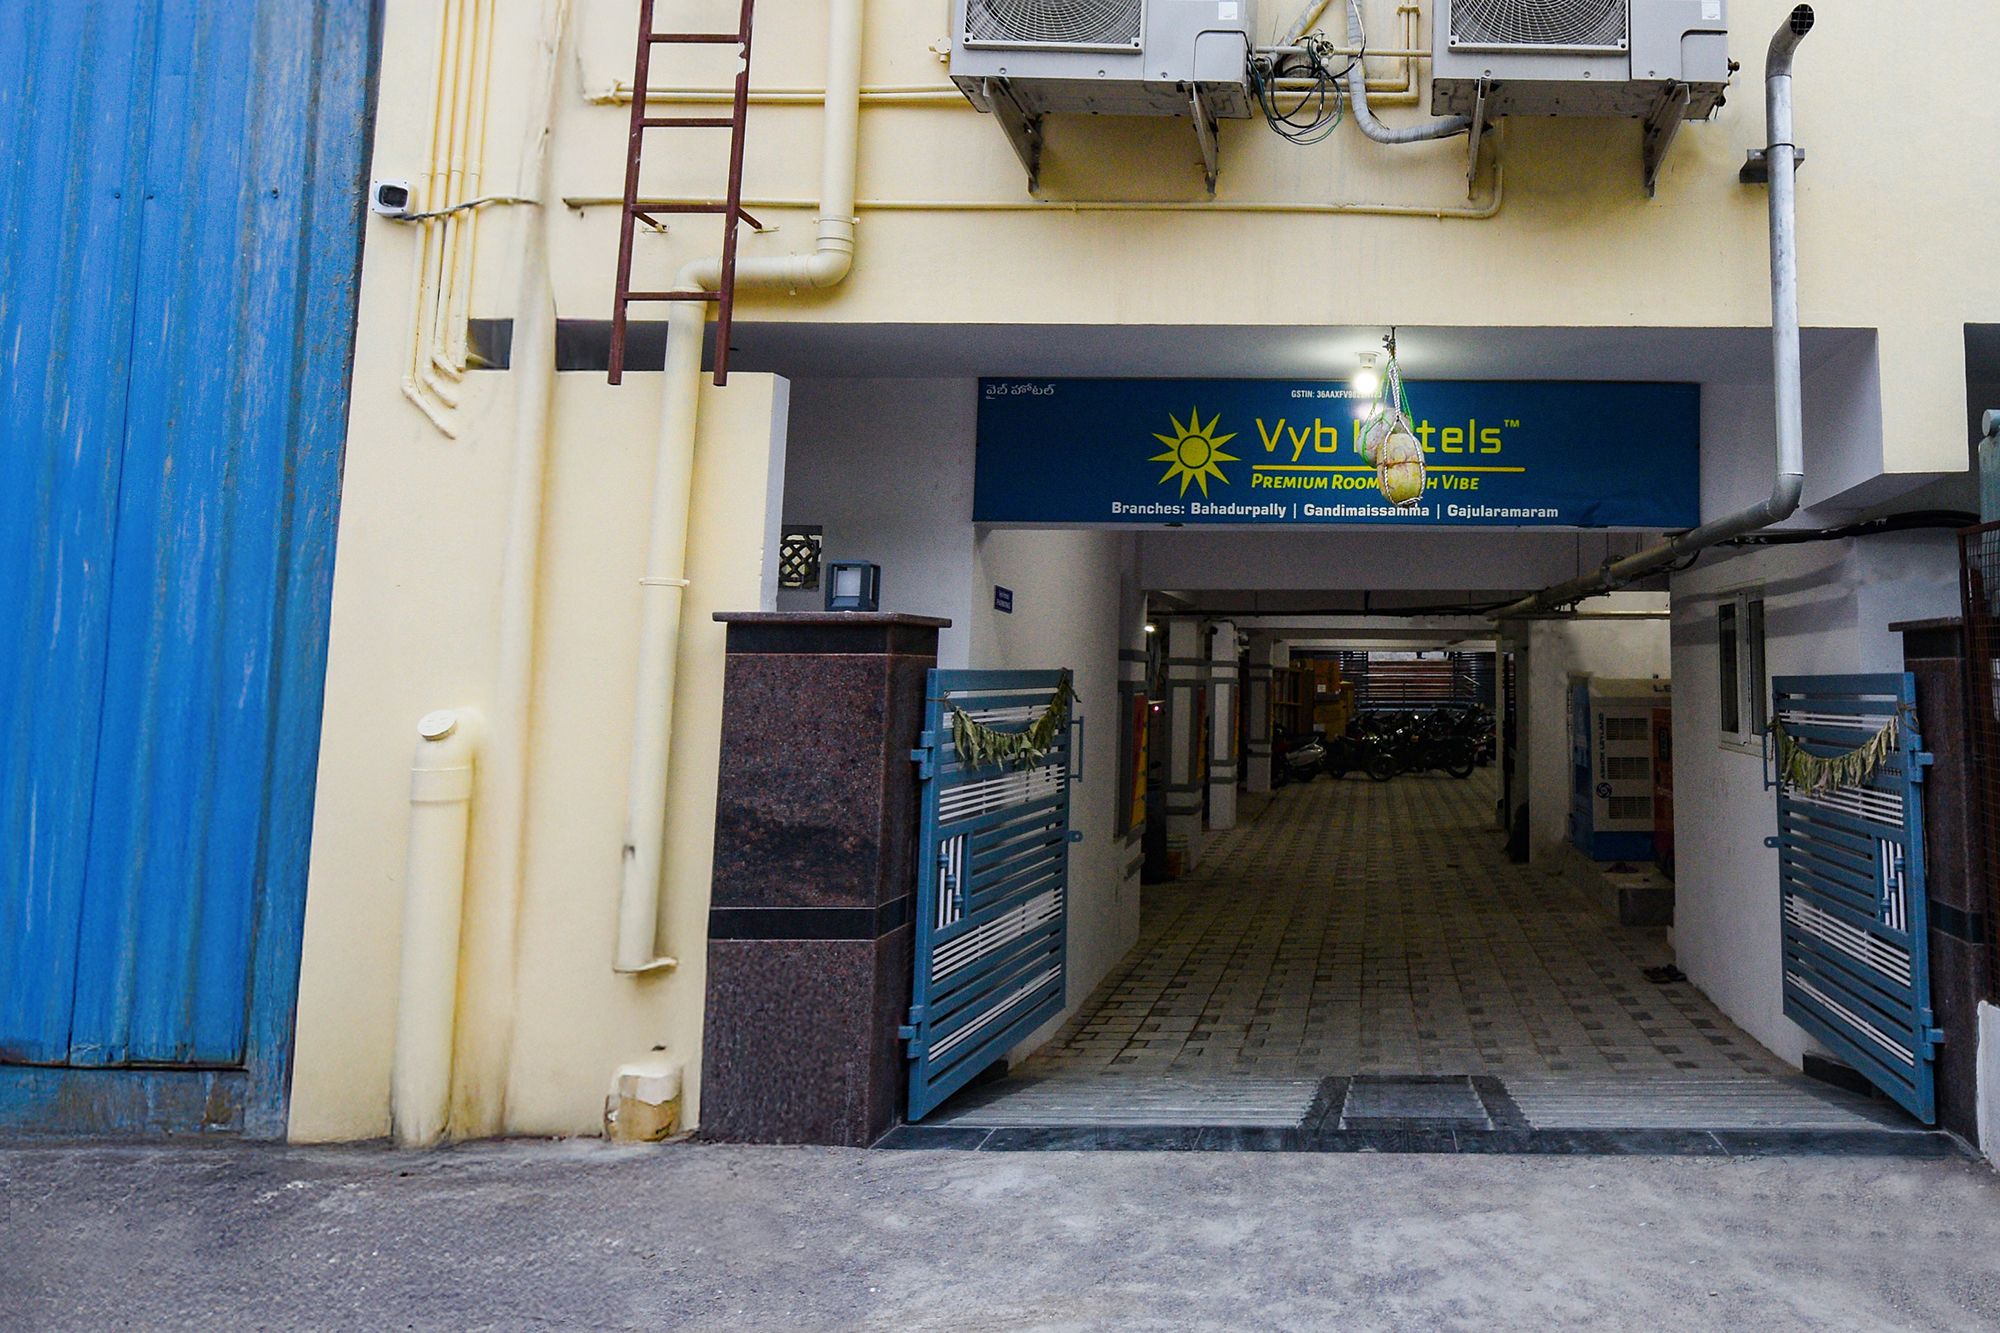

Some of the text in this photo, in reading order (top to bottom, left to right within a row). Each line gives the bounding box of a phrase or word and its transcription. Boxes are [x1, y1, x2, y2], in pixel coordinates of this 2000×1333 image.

[1291, 389, 1315, 398] GSTIN:
[1255, 418, 1338, 462] Vyb
[1111, 501, 1185, 515] Branches:
[1190, 502, 1287, 518] Bahadurpally
[1303, 502, 1430, 517] Gandimaissamma
[1447, 504, 1559, 519] Gajularamaram
